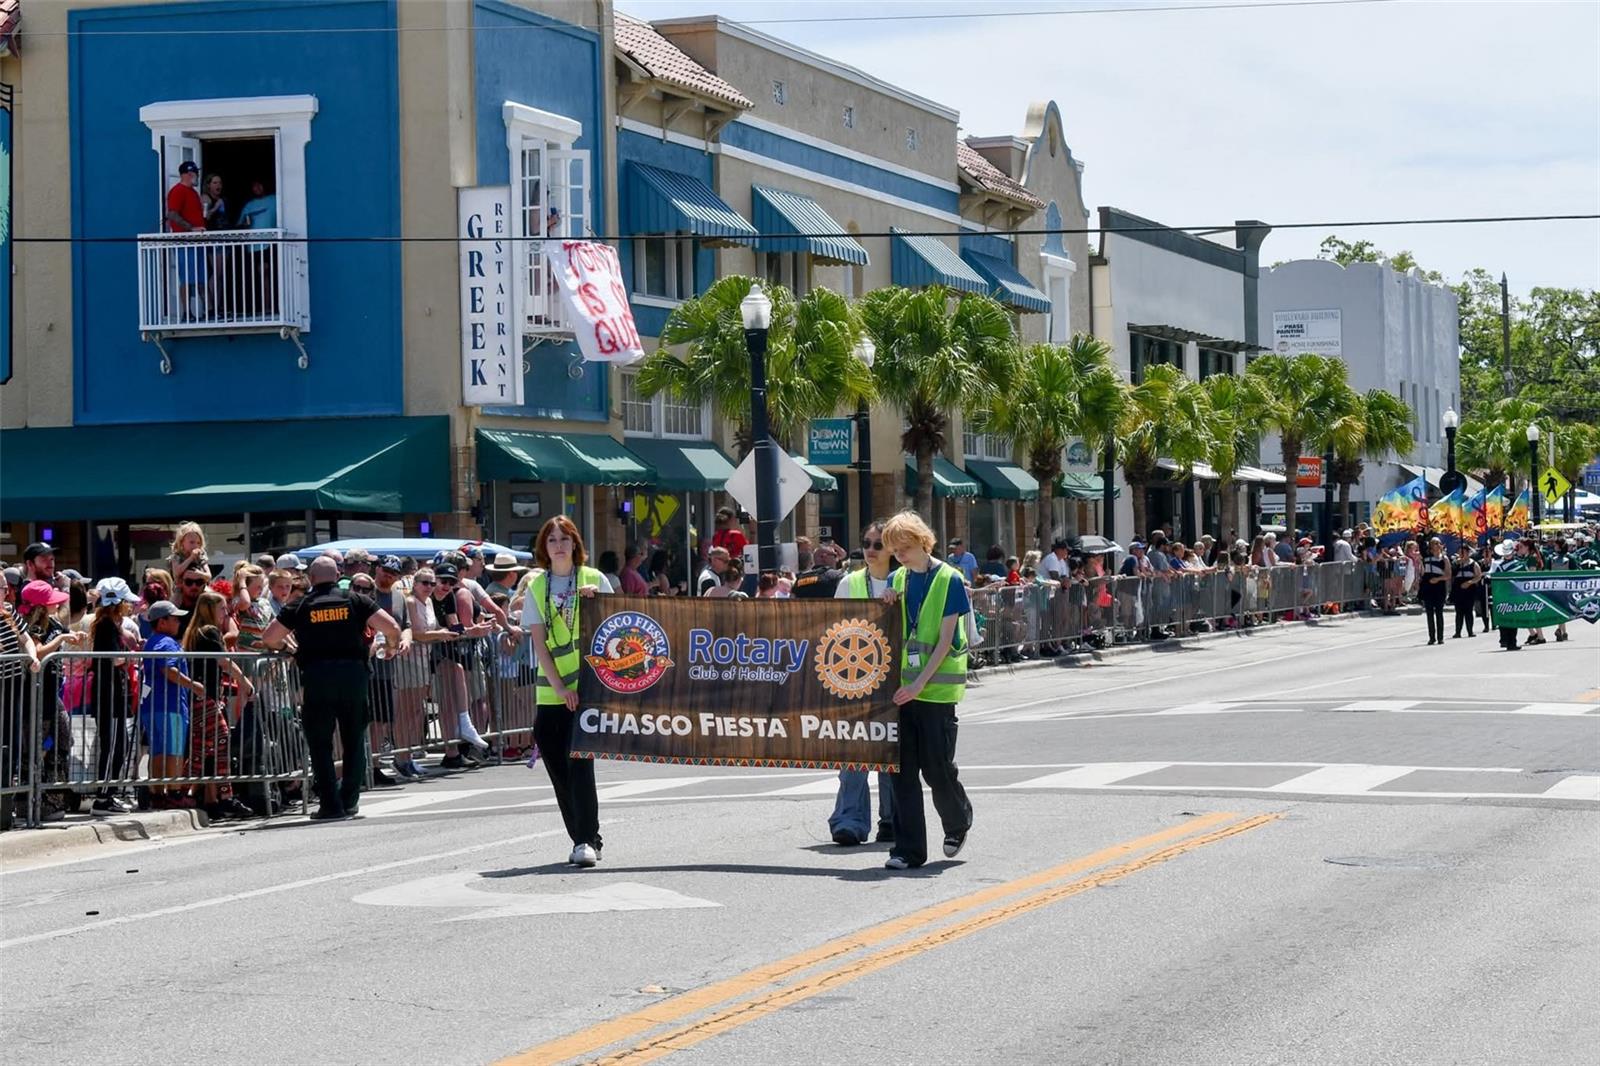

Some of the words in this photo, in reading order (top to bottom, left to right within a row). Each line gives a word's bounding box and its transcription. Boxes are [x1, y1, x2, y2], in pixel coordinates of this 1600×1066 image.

[467, 213, 487, 386] GREEK
[494, 202, 507, 397] RESTAURANT
[577, 281, 607, 317] IS
[810, 428, 849, 440] DOWN
[810, 439, 849, 450] TOWN
[1523, 581, 1558, 591] GULF
[1565, 580, 1597, 590] HIGH
[309, 607, 350, 624] SHERIFF
[1496, 601, 1546, 615] Marching
[594, 615, 632, 655] CHASCO
[634, 615, 668, 655] FIESTA
[688, 627, 810, 673] Rotary
[603, 673, 628, 690] LEGACY
[627, 682, 638, 690] OF
[637, 669, 660, 688] GIVING
[689, 666, 719, 681] Club
[720, 666, 738, 681] of
[739, 666, 789, 685] Holiday
[578, 707, 693, 736] CHASCO
[699, 712, 788, 738] FIESTA
[800, 715, 899, 743] PARADE
